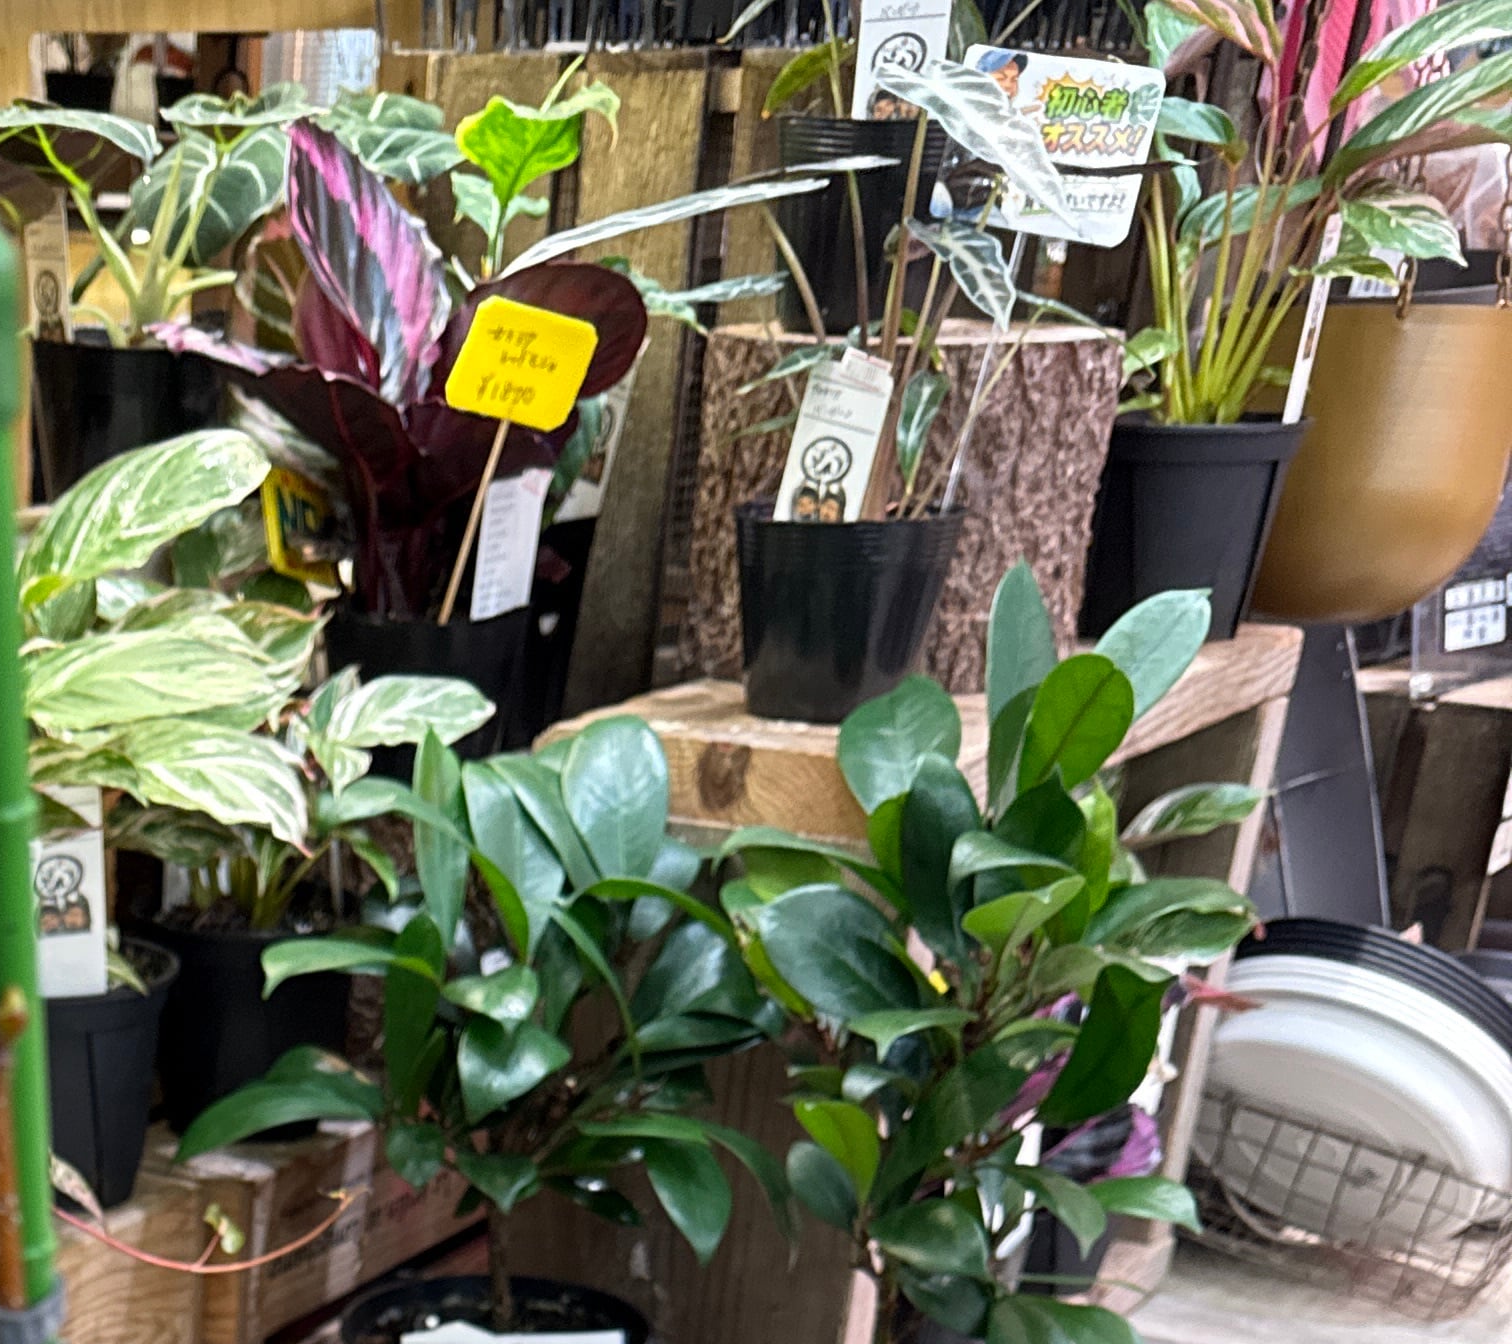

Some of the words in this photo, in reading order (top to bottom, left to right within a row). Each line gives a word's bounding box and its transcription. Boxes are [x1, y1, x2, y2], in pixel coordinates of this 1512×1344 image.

[1045, 84, 1129, 123] 初心者
[1041, 123, 1147, 155] オススメ!
